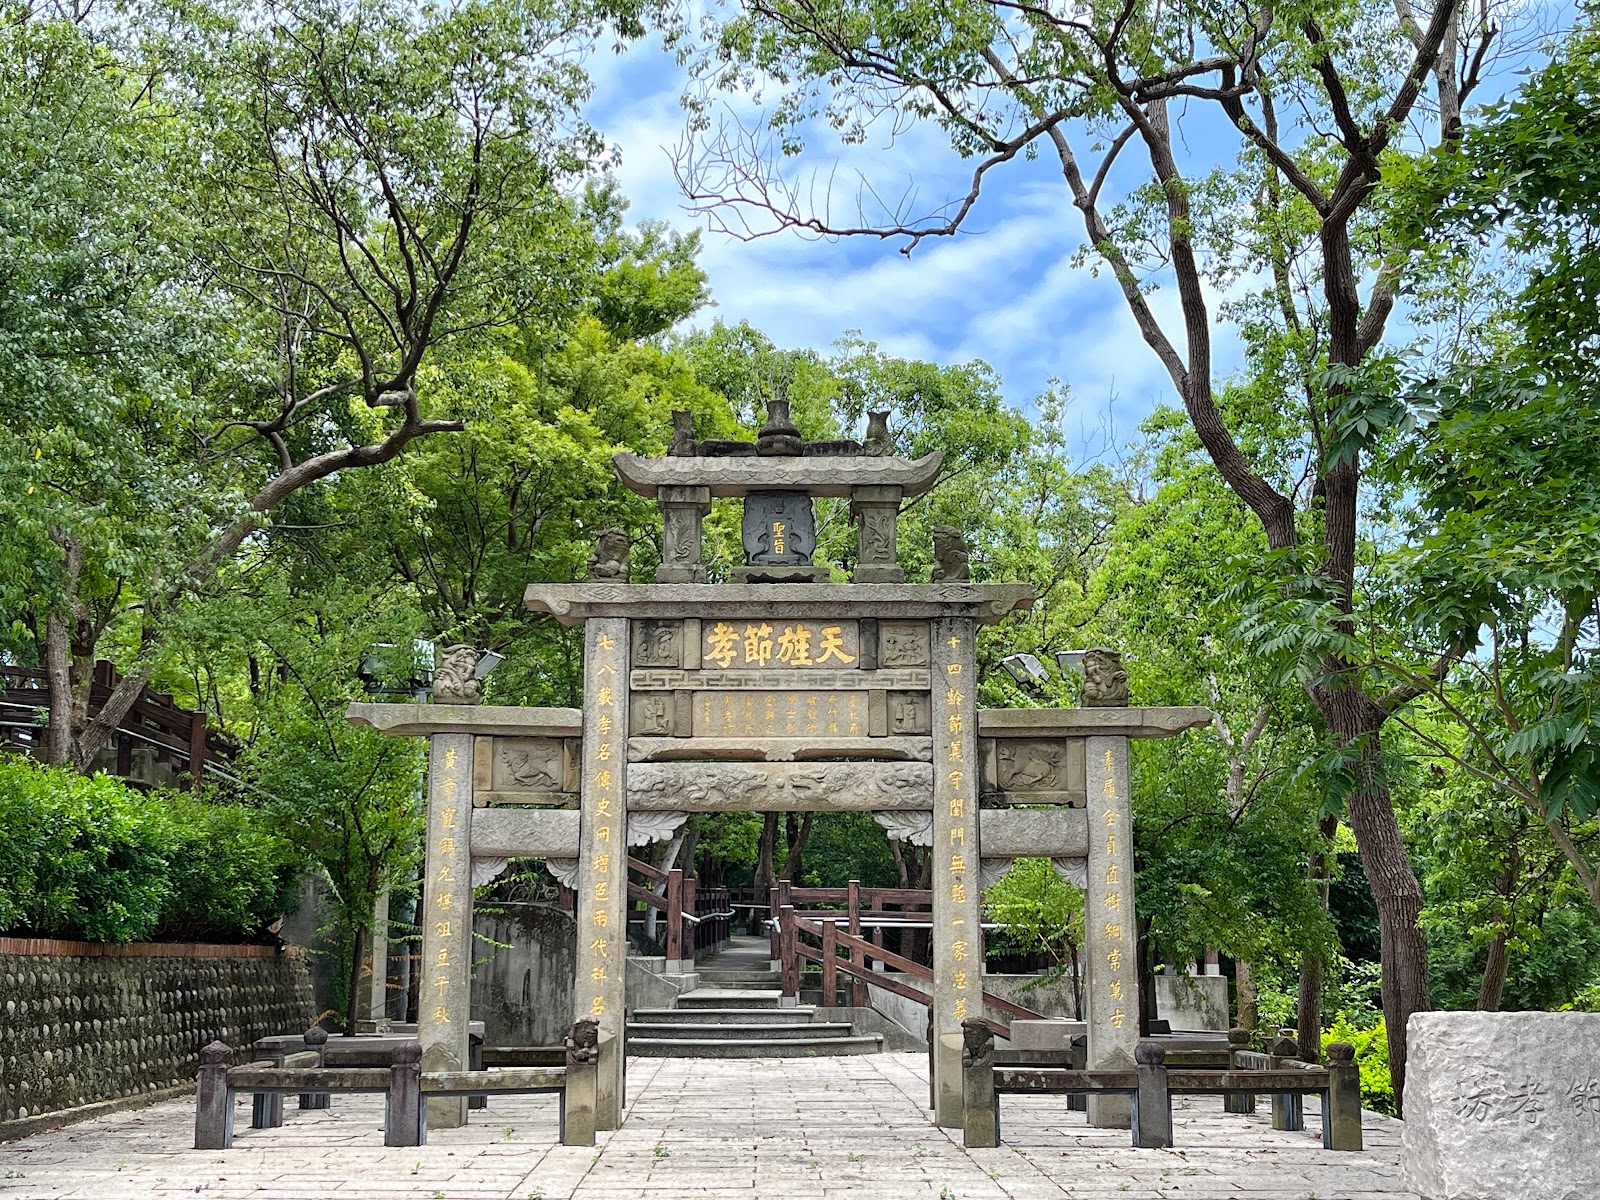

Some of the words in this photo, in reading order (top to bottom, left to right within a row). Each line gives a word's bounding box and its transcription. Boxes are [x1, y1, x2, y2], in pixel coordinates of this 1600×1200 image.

[772, 520, 786, 555] 聖旨
[703, 621, 856, 668] 天旌節孝
